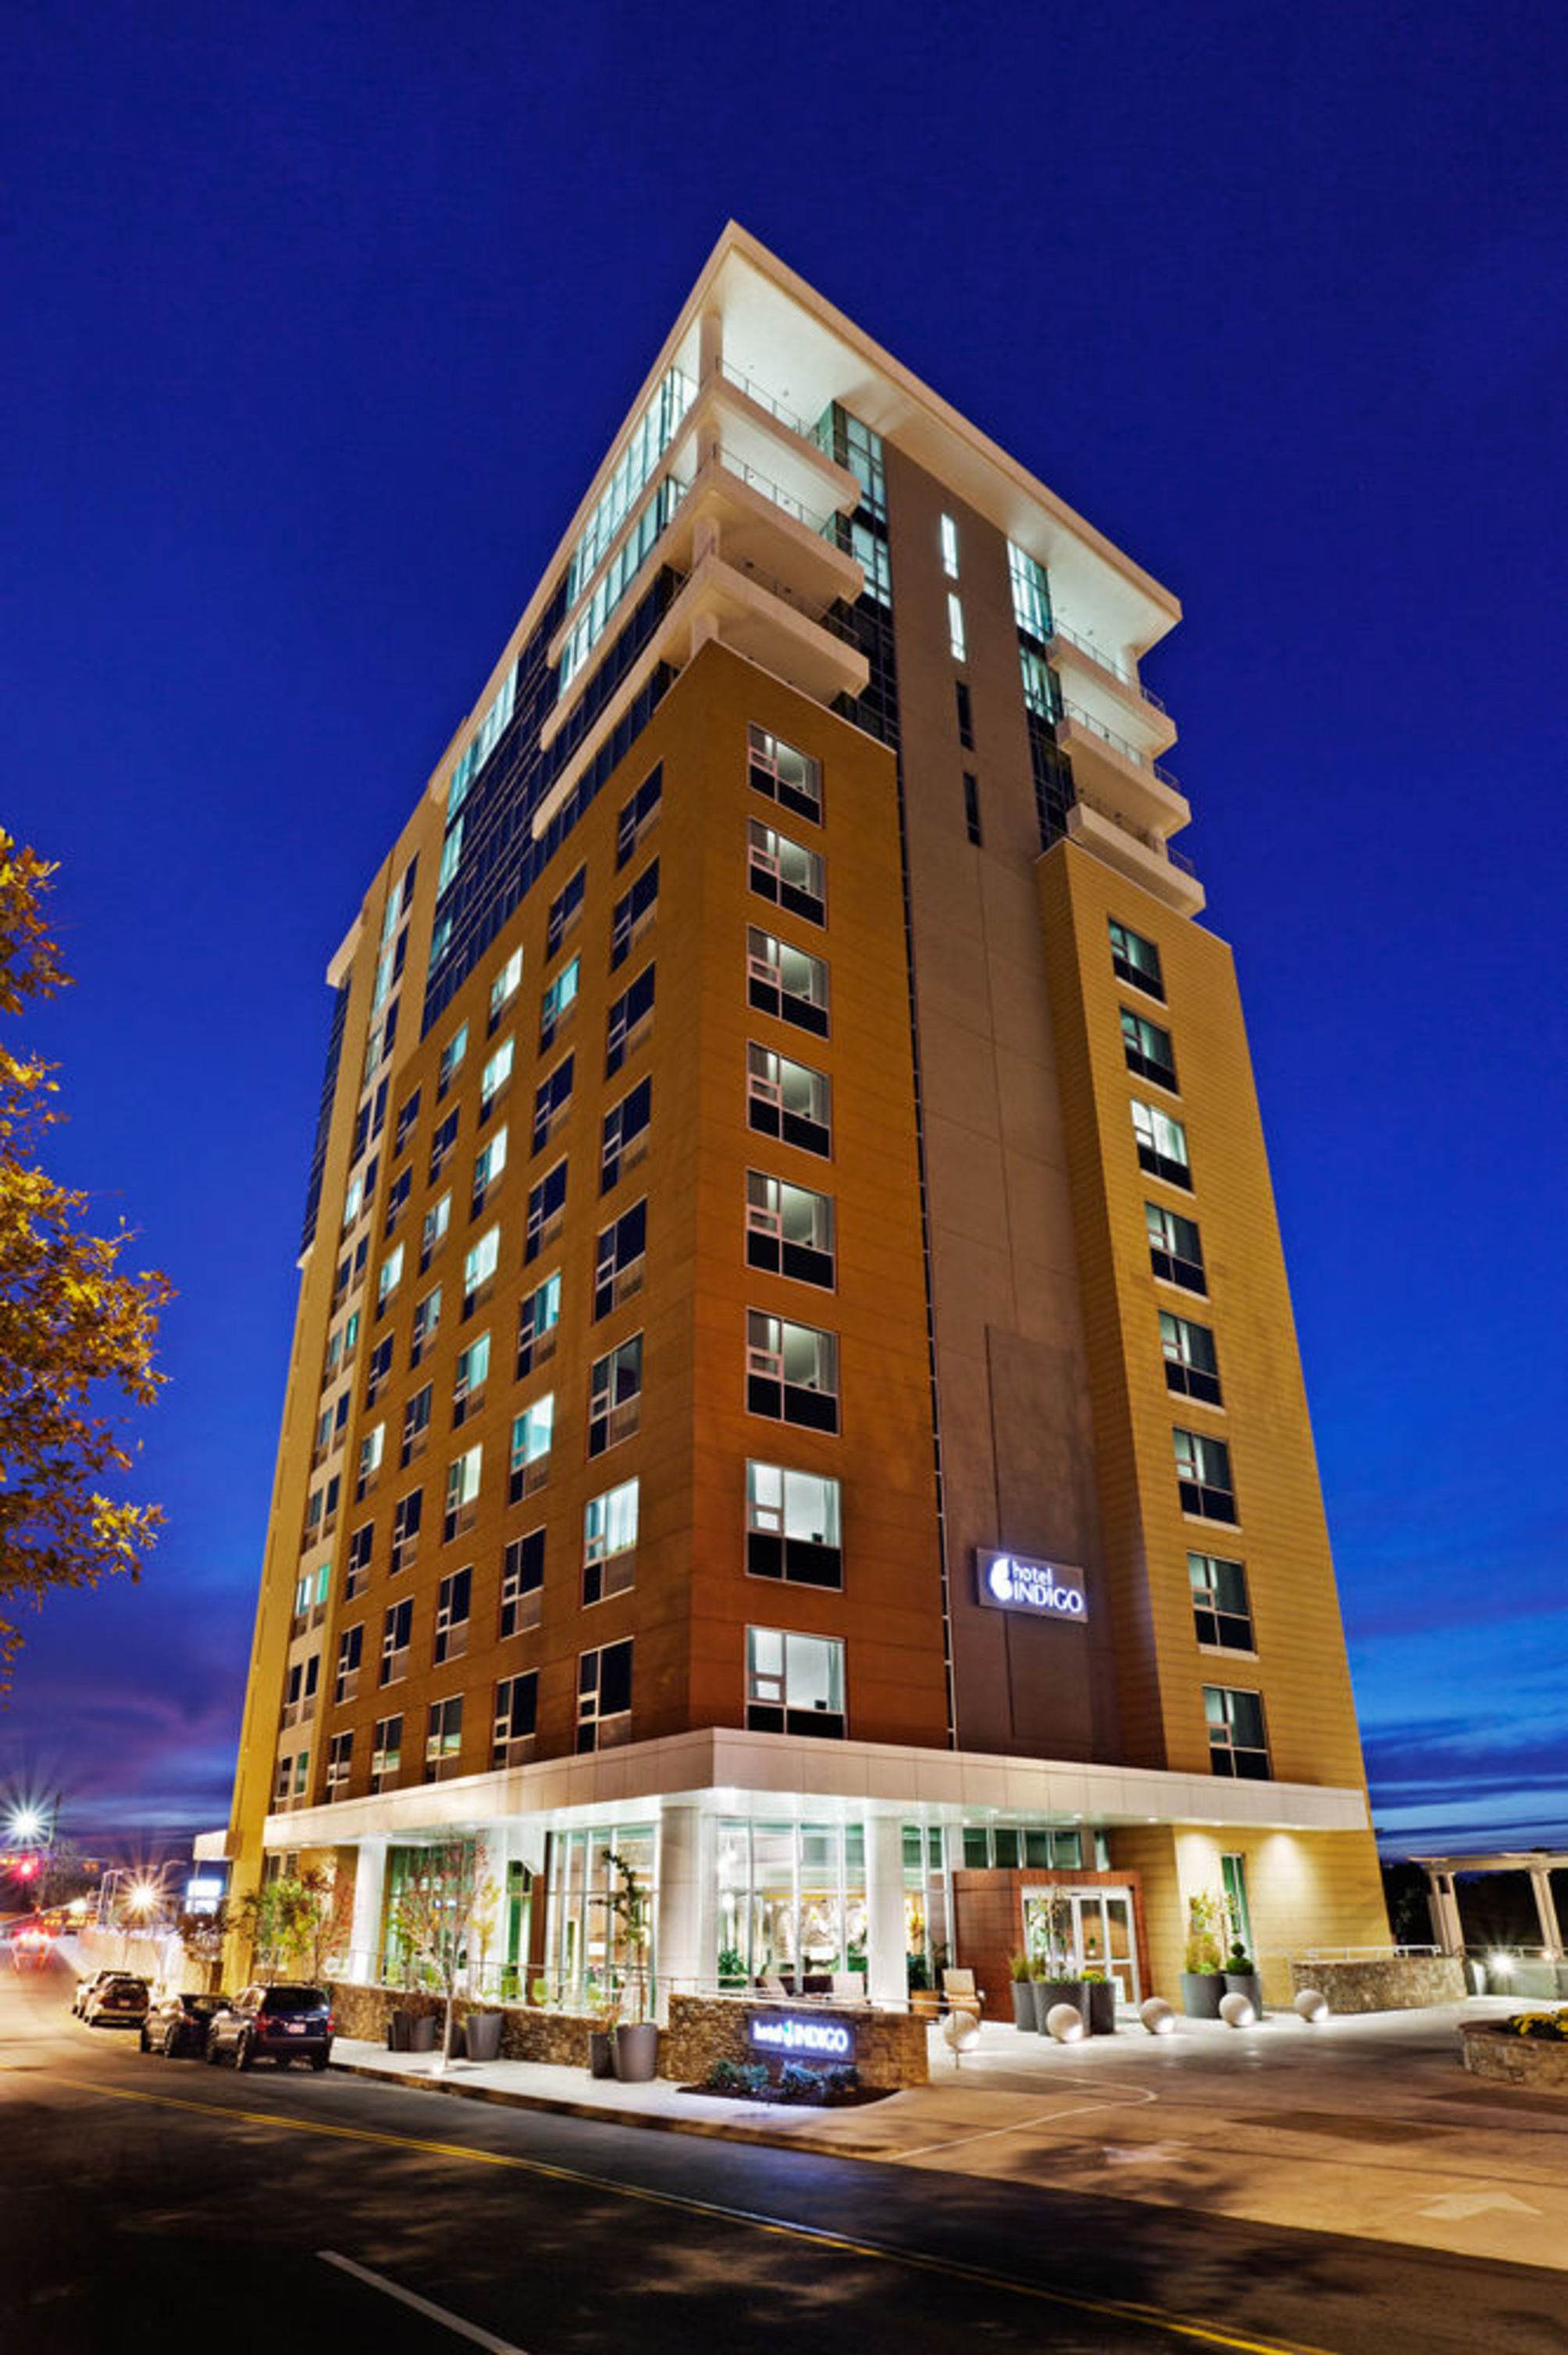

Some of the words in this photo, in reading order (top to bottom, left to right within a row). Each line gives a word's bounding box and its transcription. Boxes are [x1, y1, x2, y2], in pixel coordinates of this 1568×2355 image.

[1012, 1560, 1053, 1585] hotel
[1014, 1581, 1083, 1613] INDIGO
[794, 2025, 849, 2053] INDIGO
